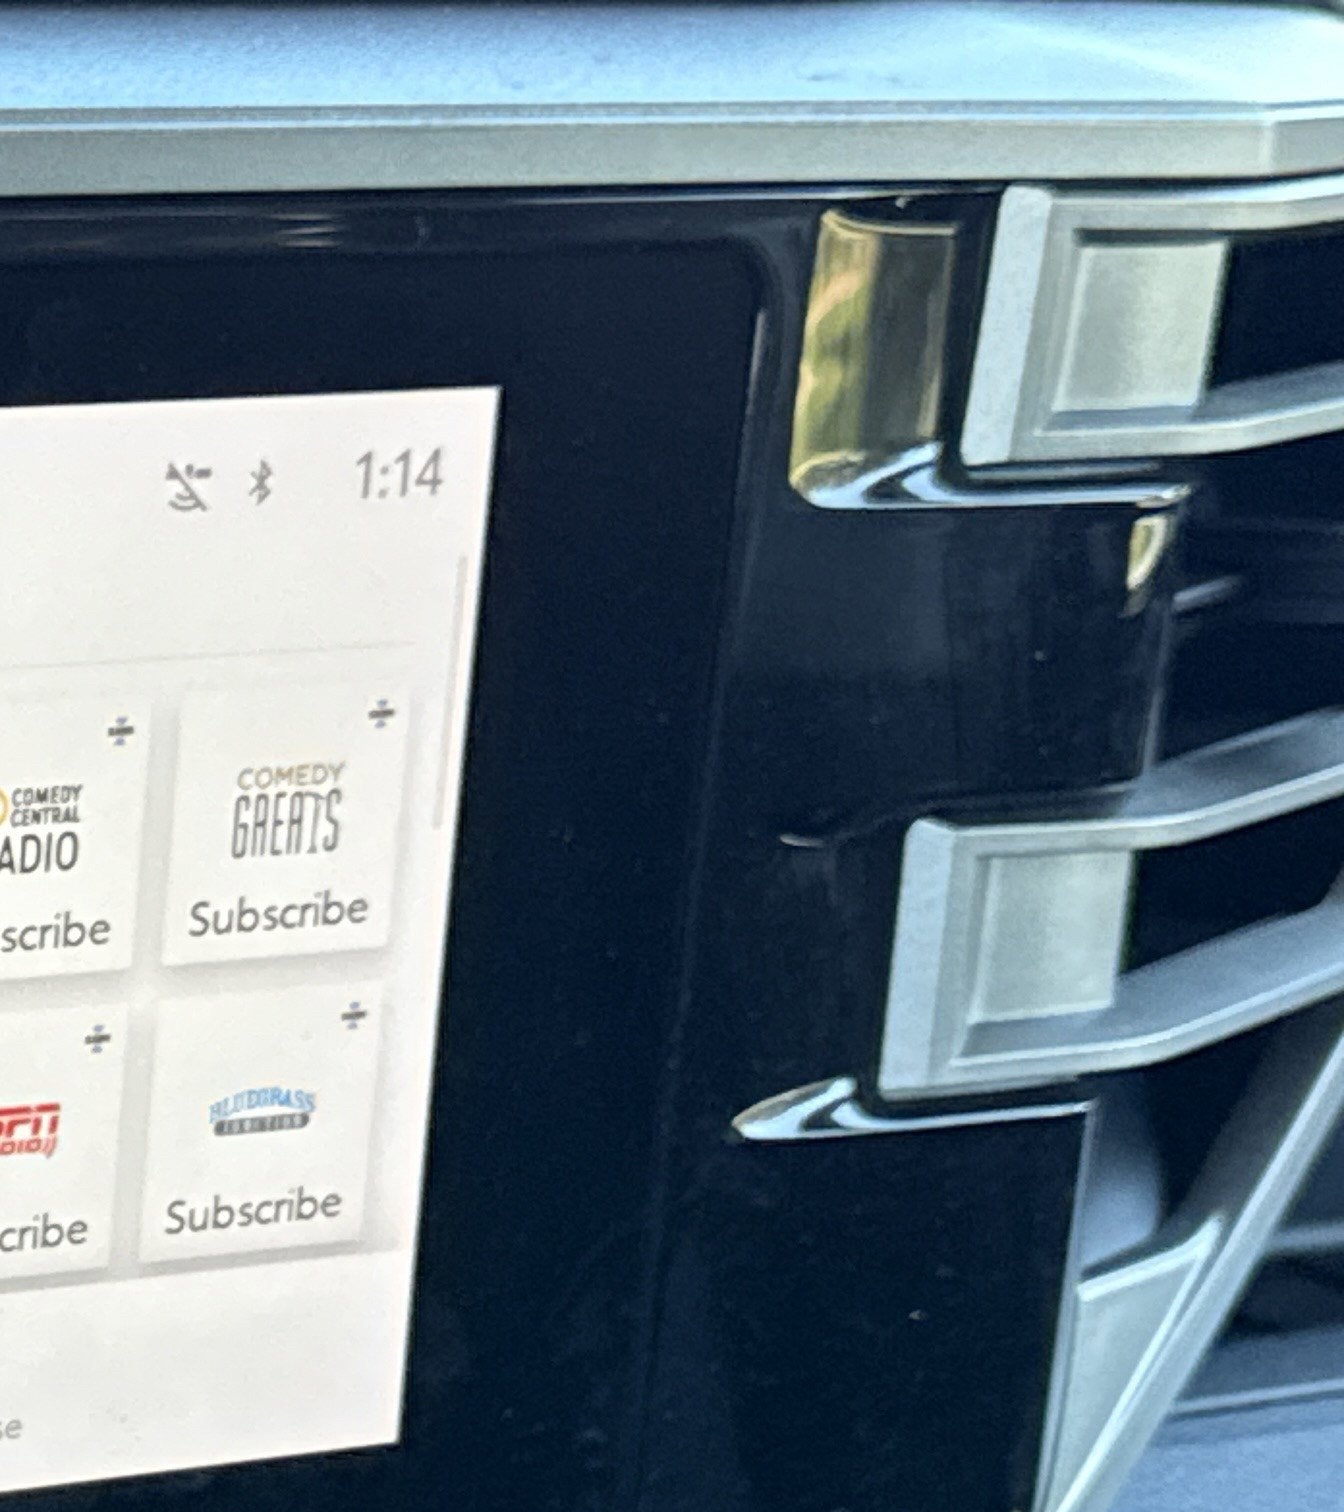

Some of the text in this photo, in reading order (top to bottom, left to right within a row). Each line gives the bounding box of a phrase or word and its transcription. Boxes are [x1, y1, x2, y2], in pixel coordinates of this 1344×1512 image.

[357, 448, 443, 499] 1:14
[12, 783, 83, 807] COMEDY
[237, 760, 346, 790] COMEDY
[10, 805, 80, 827] CENTRAL
[232, 788, 342, 858] GREATS
[189, 890, 368, 937] Subscribe
[165, 1186, 342, 1234] Subscribe
